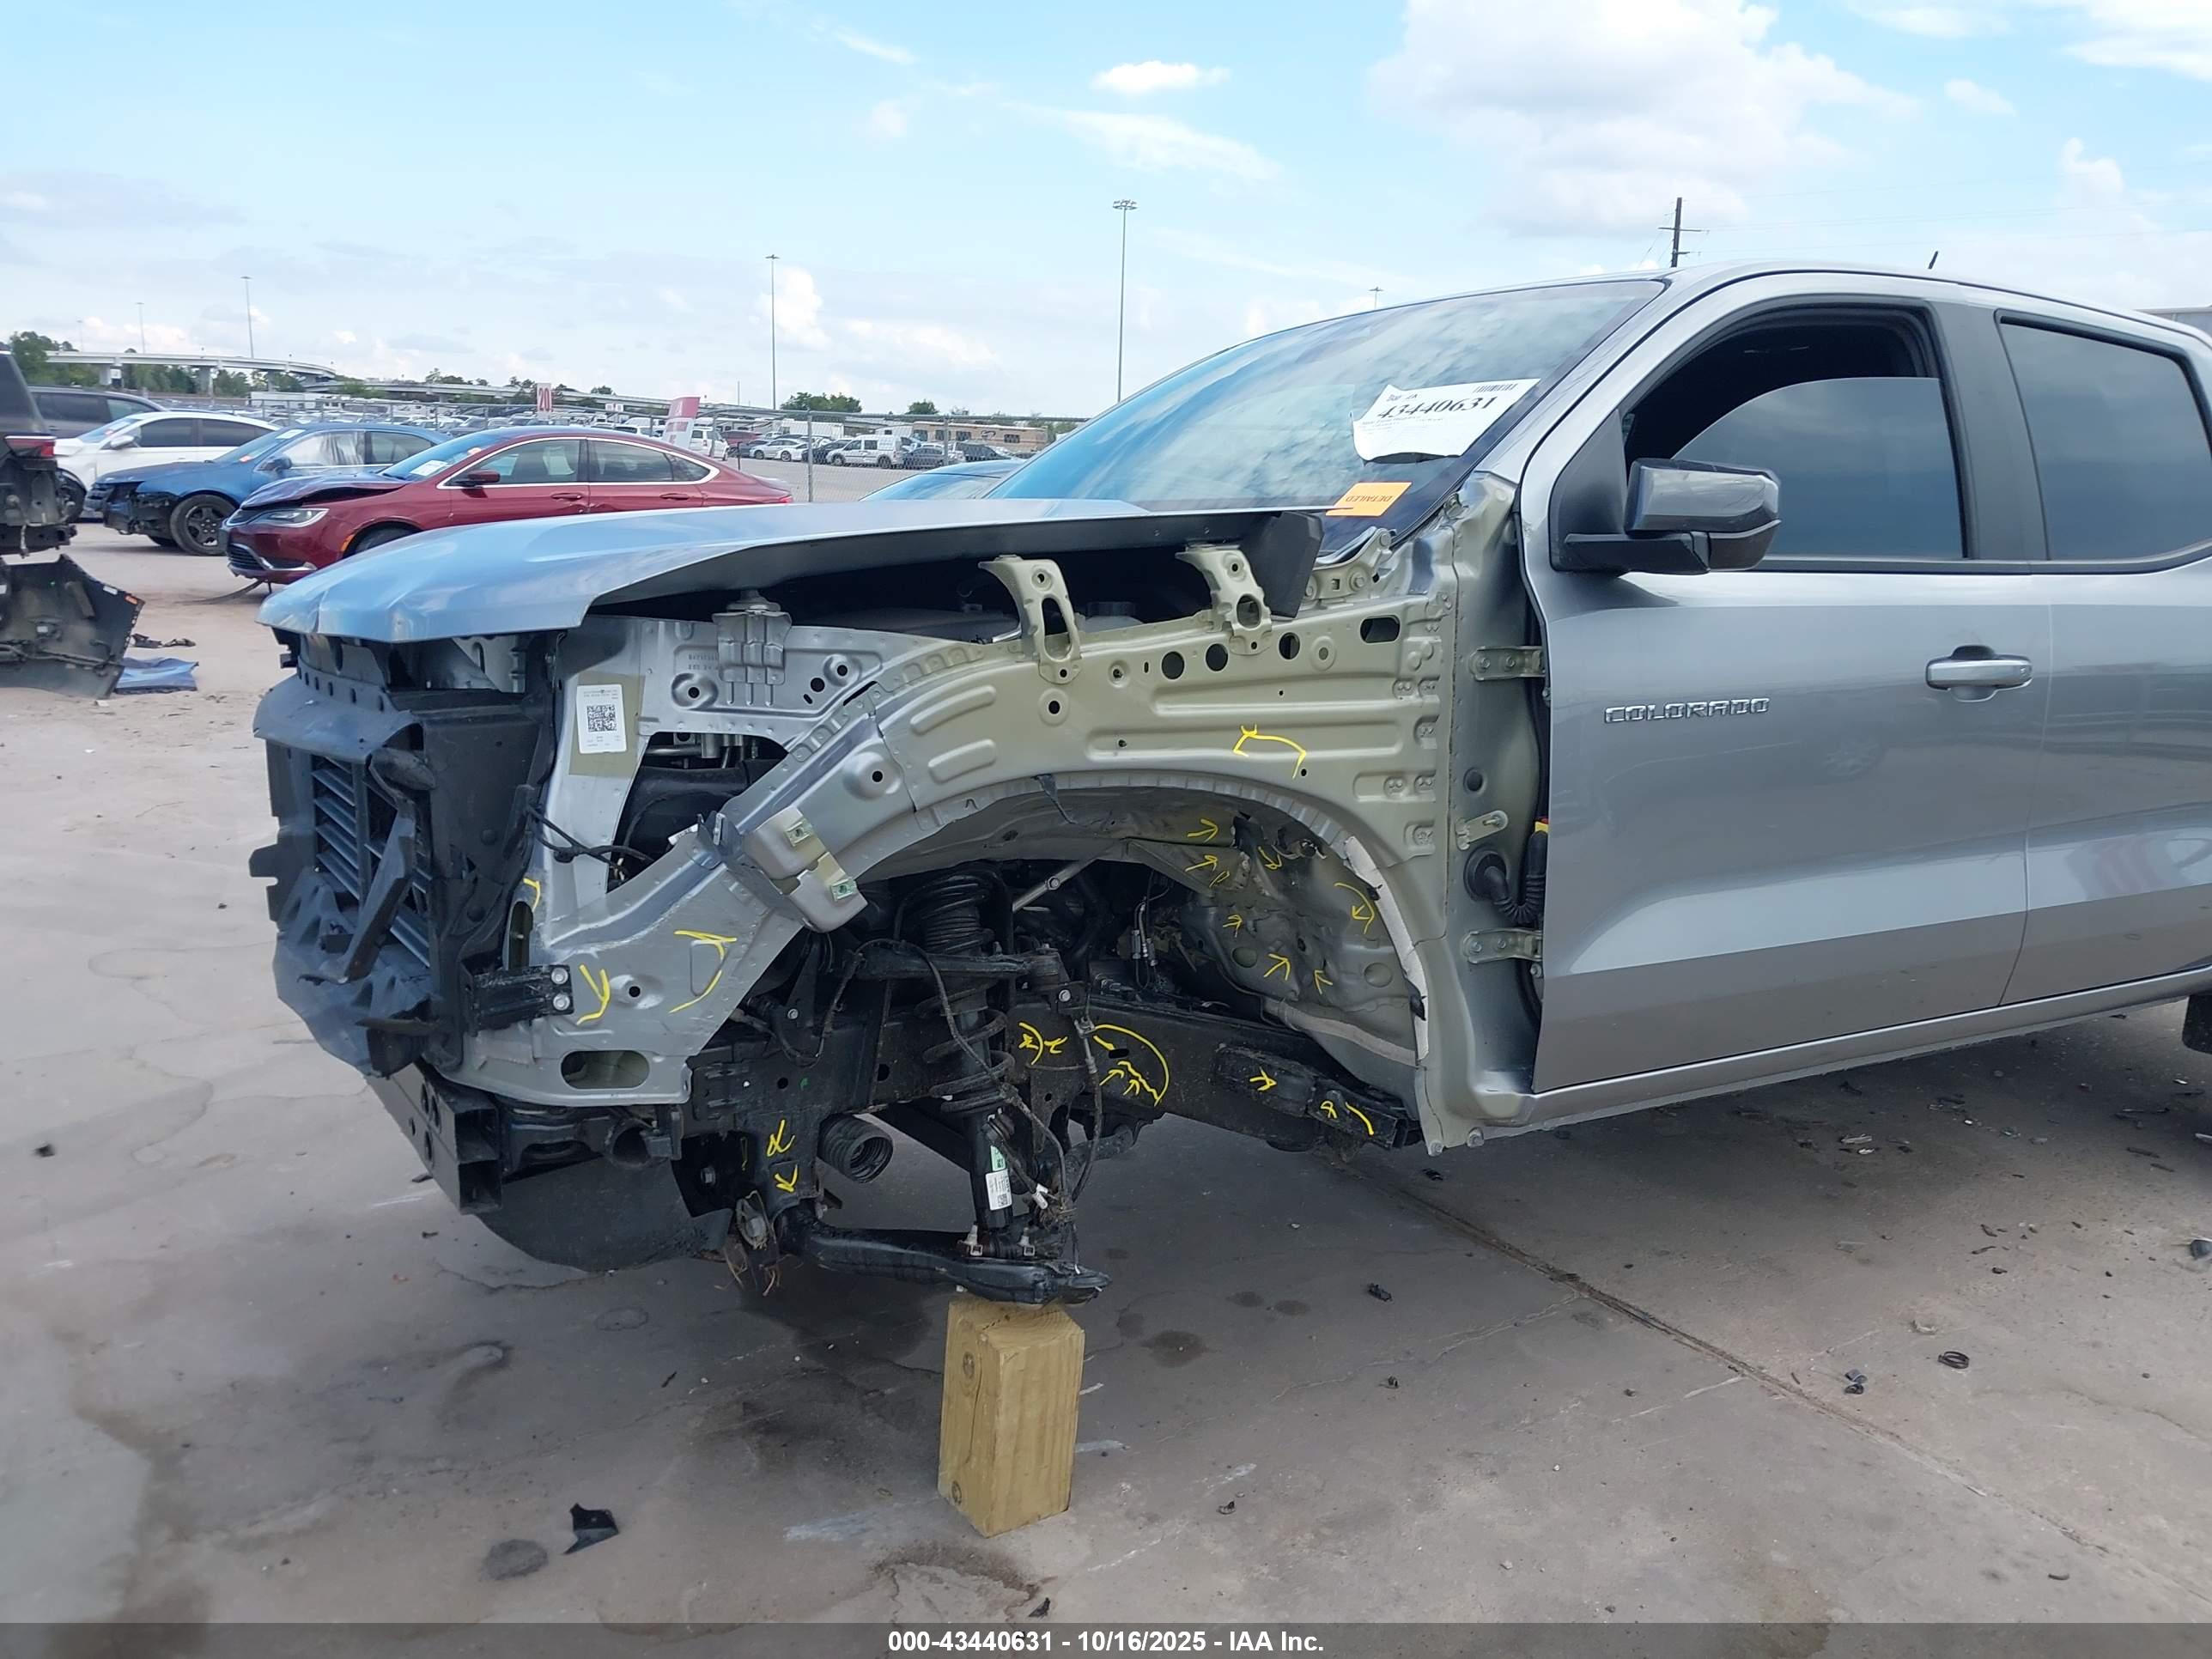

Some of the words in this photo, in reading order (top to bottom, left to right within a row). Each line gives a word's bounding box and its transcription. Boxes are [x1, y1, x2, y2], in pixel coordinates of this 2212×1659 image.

[538, 387, 550, 412] 20
[1377, 396, 1498, 419] 43440631
[1604, 696, 1771, 723] COLORADO
